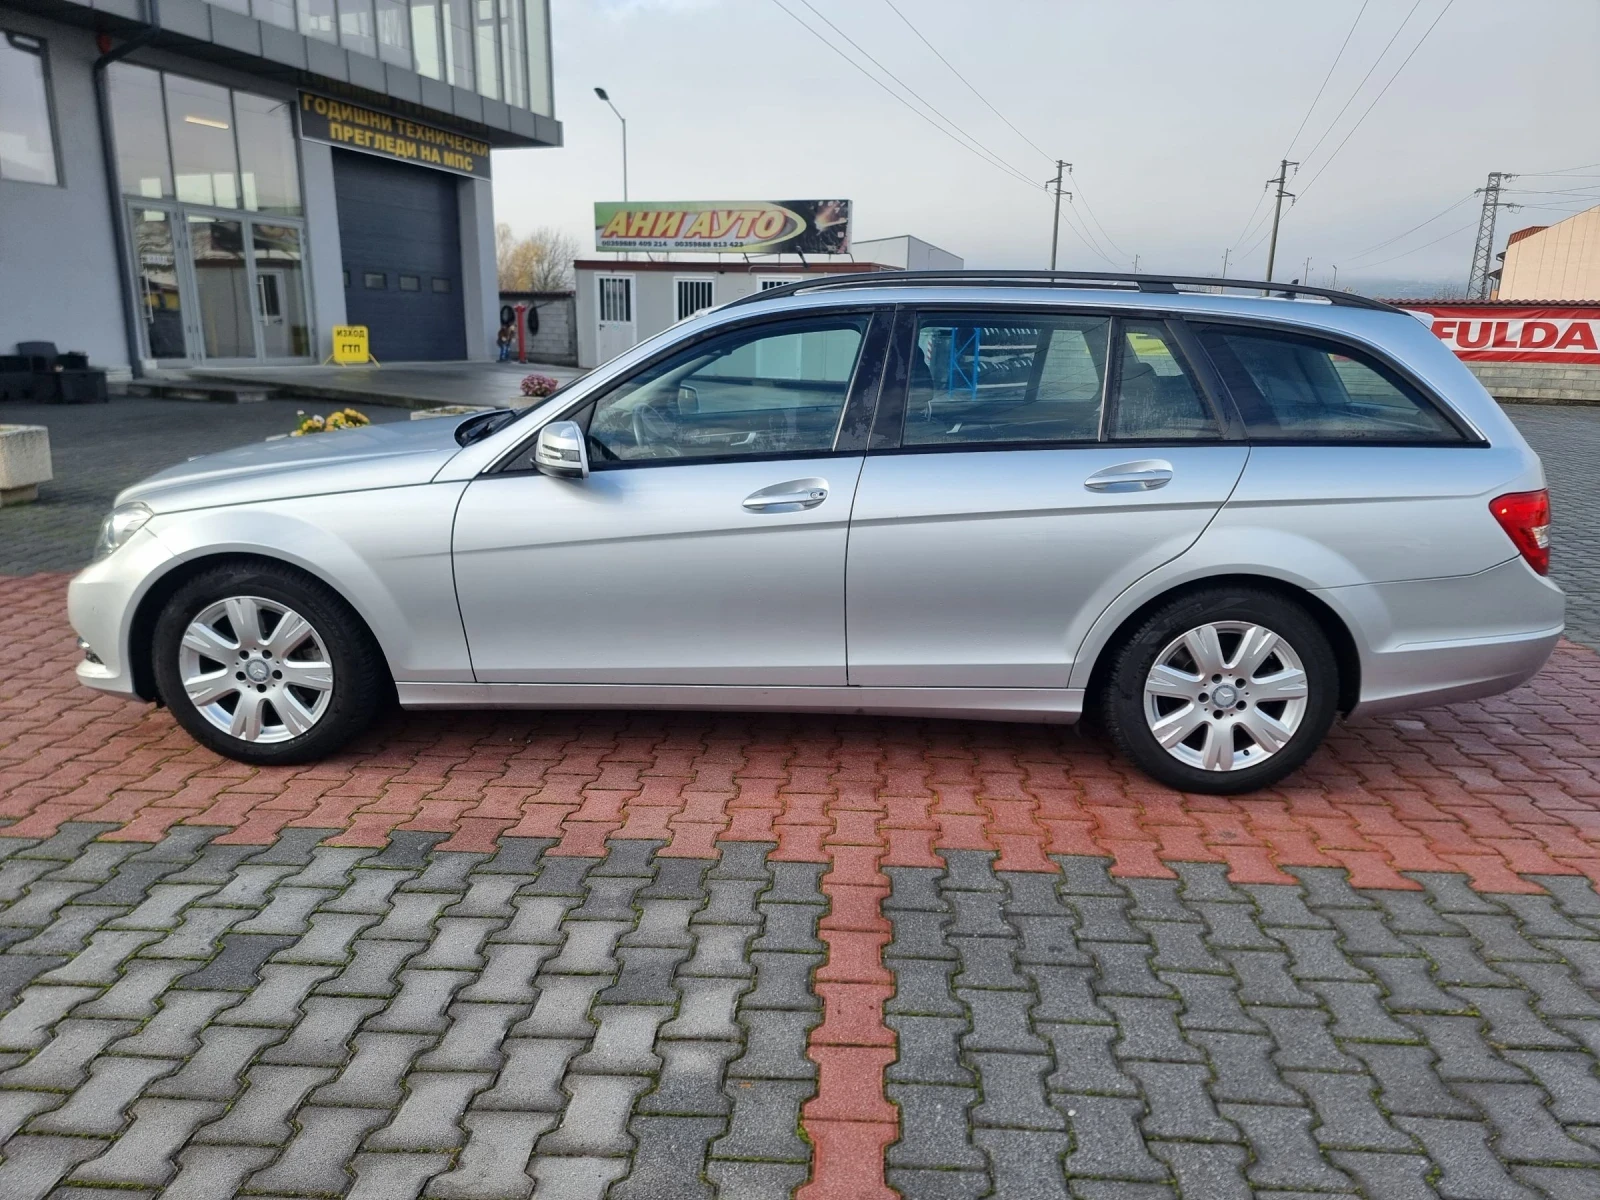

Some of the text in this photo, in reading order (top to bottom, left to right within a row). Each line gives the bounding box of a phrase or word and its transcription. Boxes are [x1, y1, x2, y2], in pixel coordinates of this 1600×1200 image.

[303, 94, 488, 157] ГОДИШНИ ТЕХНИЧЕСКИ
[330, 122, 474, 172] ПРЕГЛЕДИ НА МПС
[602, 209, 786, 239] АНИ АУТО
[729, 241, 744, 249] 423
[336, 329, 365, 338] ИЗХОД
[1430, 321, 1599, 350] FULDA
[342, 344, 361, 353] ГТП
